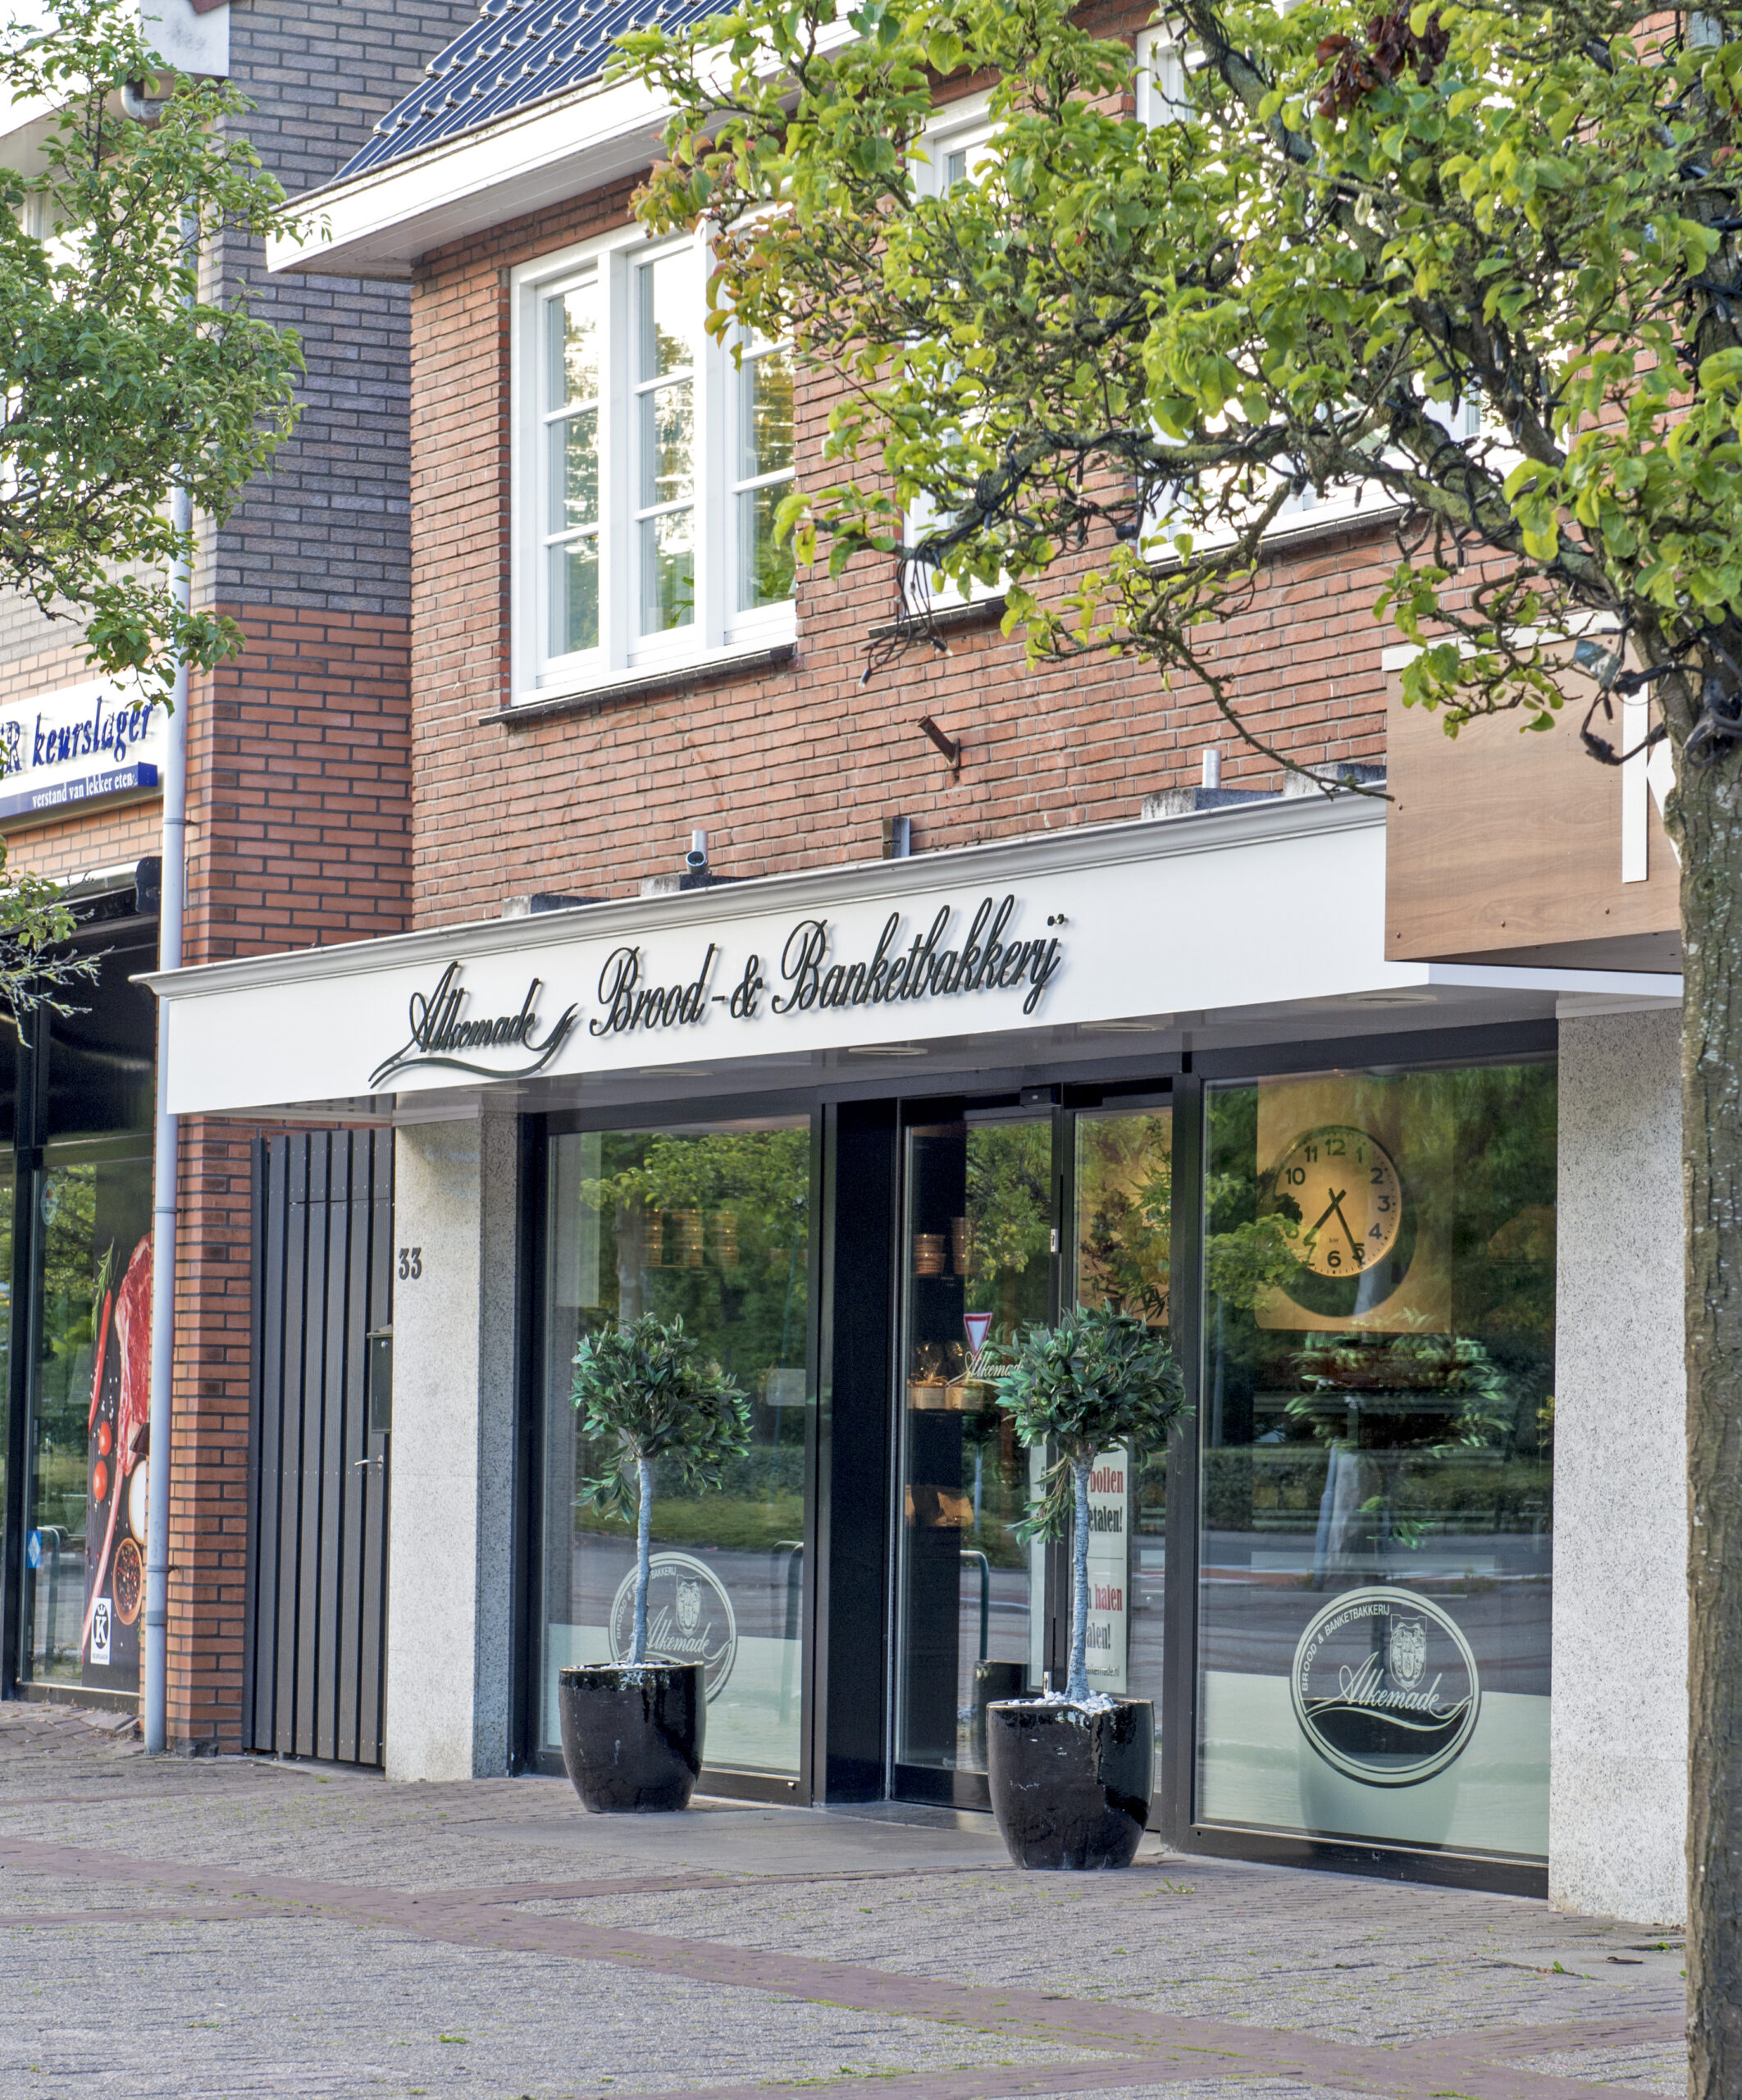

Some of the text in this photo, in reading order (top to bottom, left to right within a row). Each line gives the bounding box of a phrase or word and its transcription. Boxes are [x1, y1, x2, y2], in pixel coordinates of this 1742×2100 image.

[32, 696, 153, 767] keurslager
[32, 782, 67, 808] verstand
[69, 784, 84, 800] van
[85, 774, 113, 796] lekker
[385, 961, 574, 1062] Alkemade
[731, 955, 763, 1018] &
[1304, 1146, 1318, 1162] 11
[1325, 1139, 1346, 1156] 12
[1356, 1147, 1362, 1163] 1
[1285, 1167, 1306, 1185] 10
[1370, 1167, 1384, 1185] 2
[1378, 1195, 1390, 1212] 3
[1369, 1223, 1383, 1239] 4
[399, 1247, 422, 1280] 33
[1327, 1250, 1342, 1268] 6
[961, 1340, 1024, 1377] Alkemad
[1088, 1506, 1123, 1532] etalen!
[1095, 1584, 1123, 1611] halen
[95, 1615, 107, 1643] K
[617, 1600, 627, 1639] BROOD
[645, 1605, 714, 1655] Alkemade
[1302, 1604, 1391, 1691] BROOD & BANKETBAKKERIJ
[1329, 1651, 1448, 1716] Alkemade
